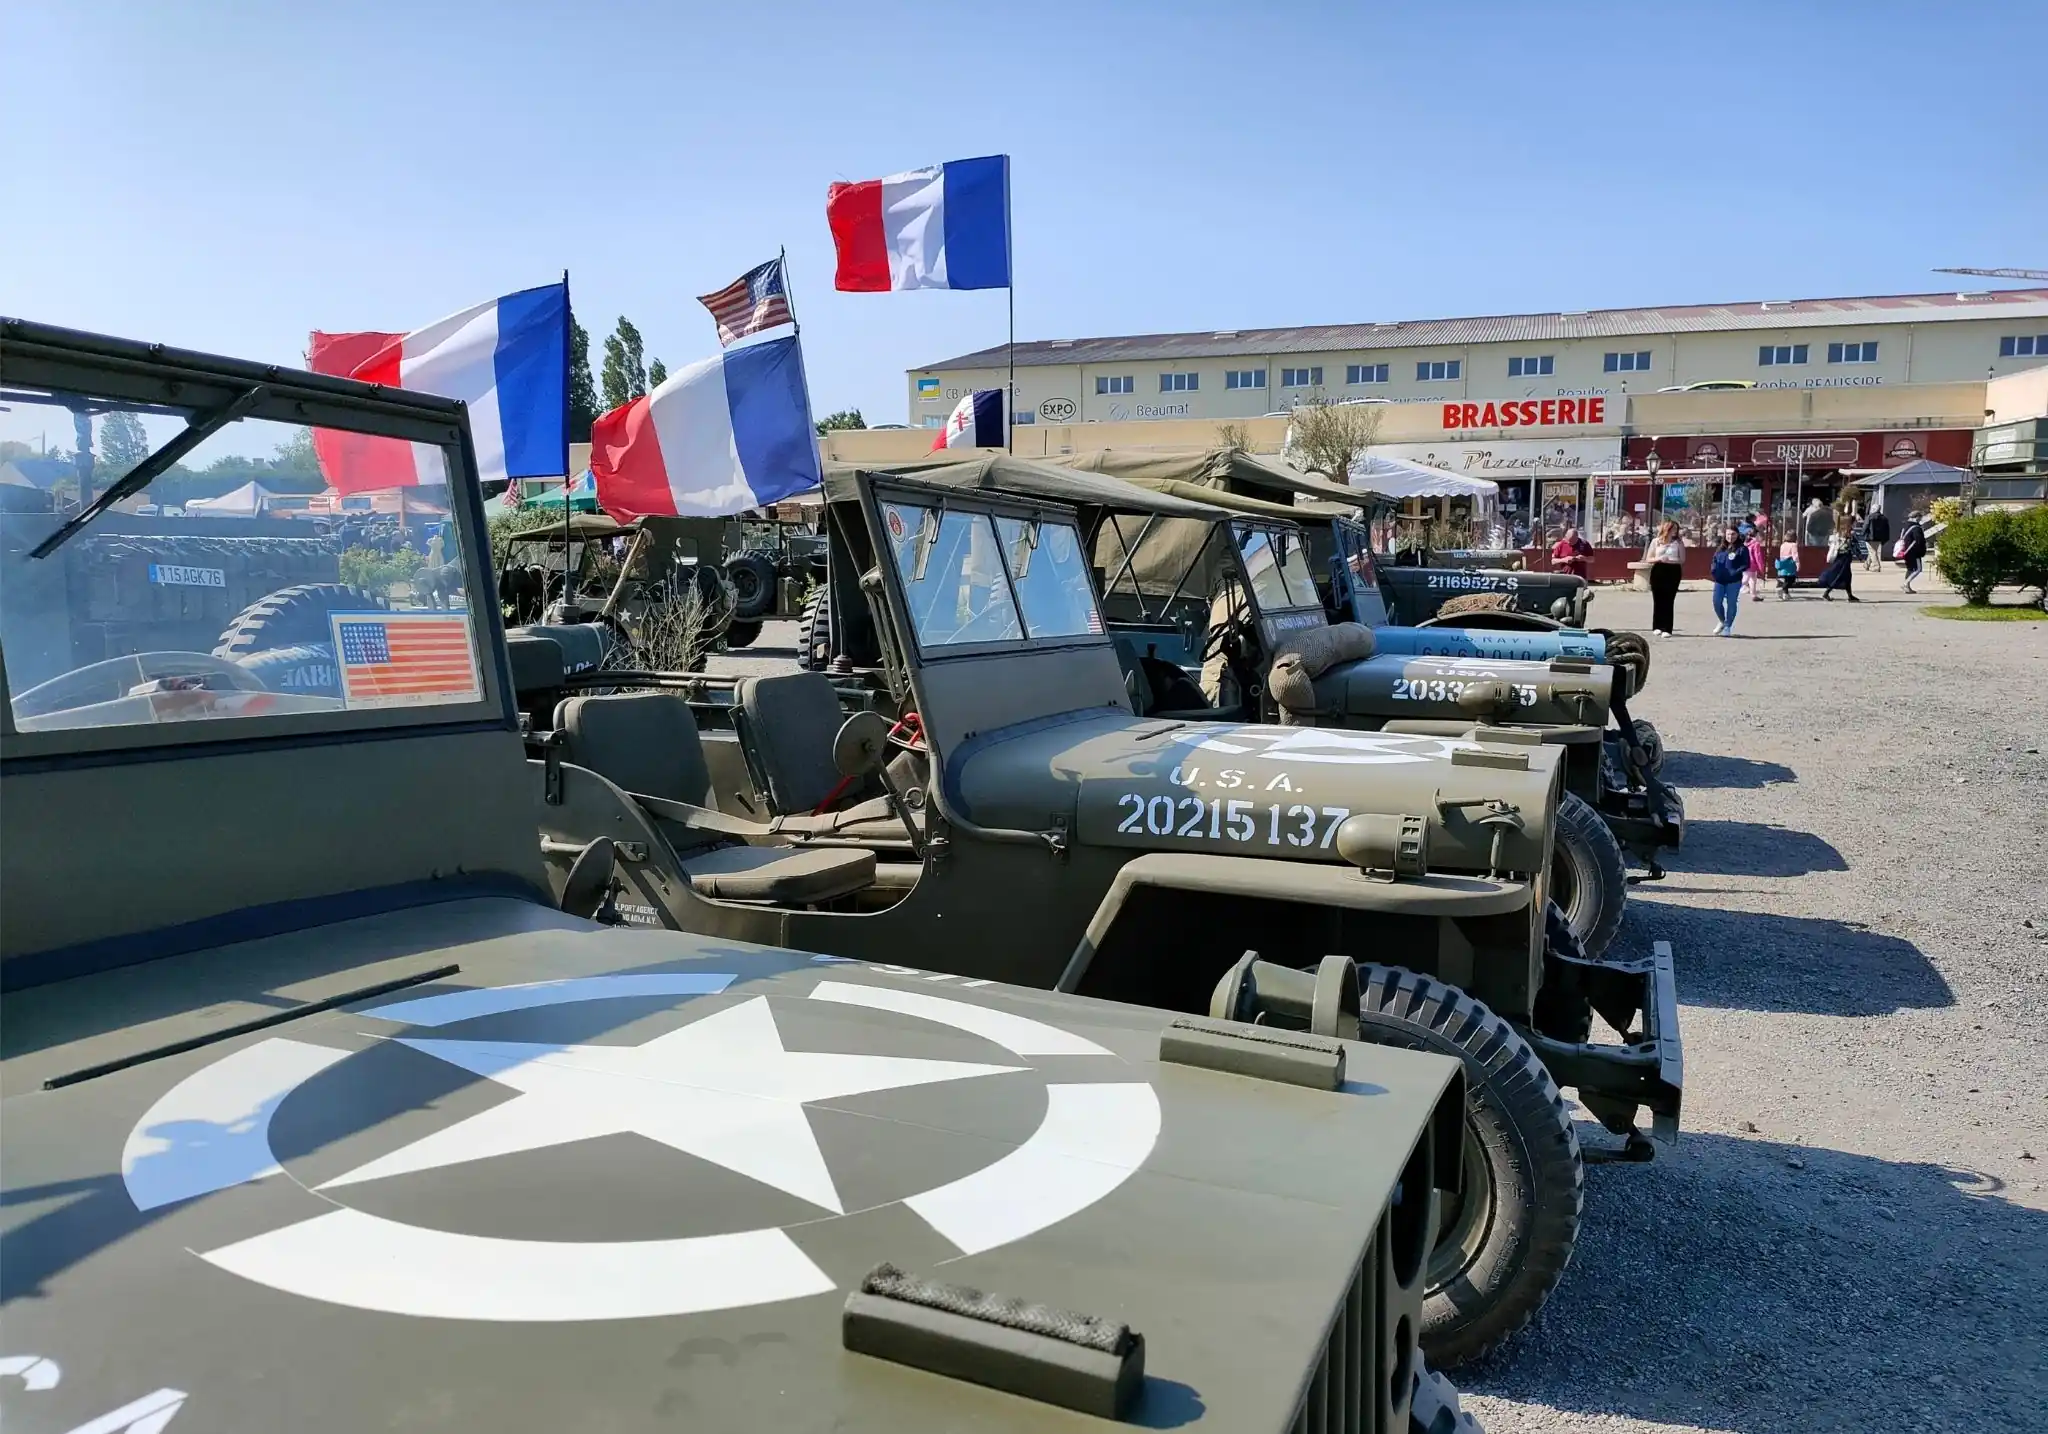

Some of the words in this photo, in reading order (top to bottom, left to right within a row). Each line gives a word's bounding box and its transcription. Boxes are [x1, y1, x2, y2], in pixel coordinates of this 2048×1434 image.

[1043, 404, 1074, 415] EXPO
[1136, 402, 1189, 416] Beaumat
[1443, 398, 1605, 429] BRASSERIE
[1462, 448, 1584, 470] Pizzeria
[1777, 444, 1834, 459] BISTROT
[206, 570, 222, 585] 76
[1428, 575, 1519, 590] 21169527-S
[1391, 678, 1538, 707] 20335
[621, 903, 635, 913] PORT
